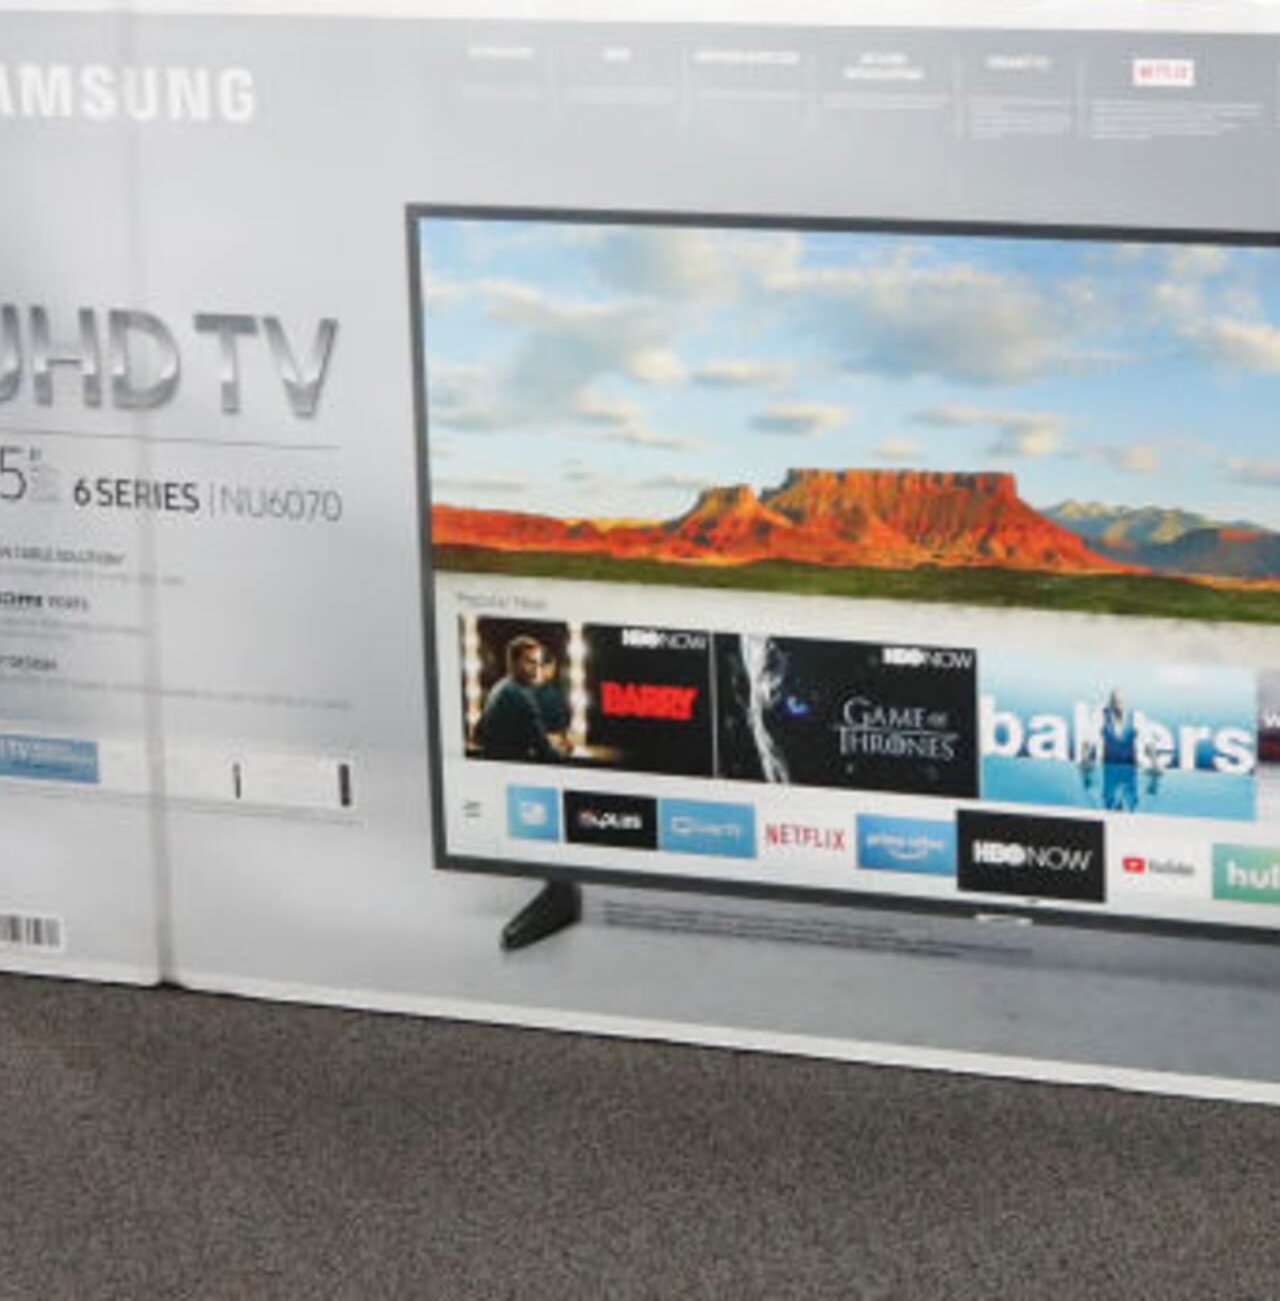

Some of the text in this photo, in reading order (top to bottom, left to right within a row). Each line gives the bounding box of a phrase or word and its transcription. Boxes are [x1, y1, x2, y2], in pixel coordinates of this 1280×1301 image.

[194, 312, 340, 419] TV
[73, 479, 92, 508] 6
[95, 478, 201, 514] SERIES
[221, 487, 343, 523] NU6070
[600, 680, 700, 721] BARRY
[842, 696, 927, 729] GAME
[838, 726, 956, 762] THRONES
[764, 822, 846, 852] NETFLIX
